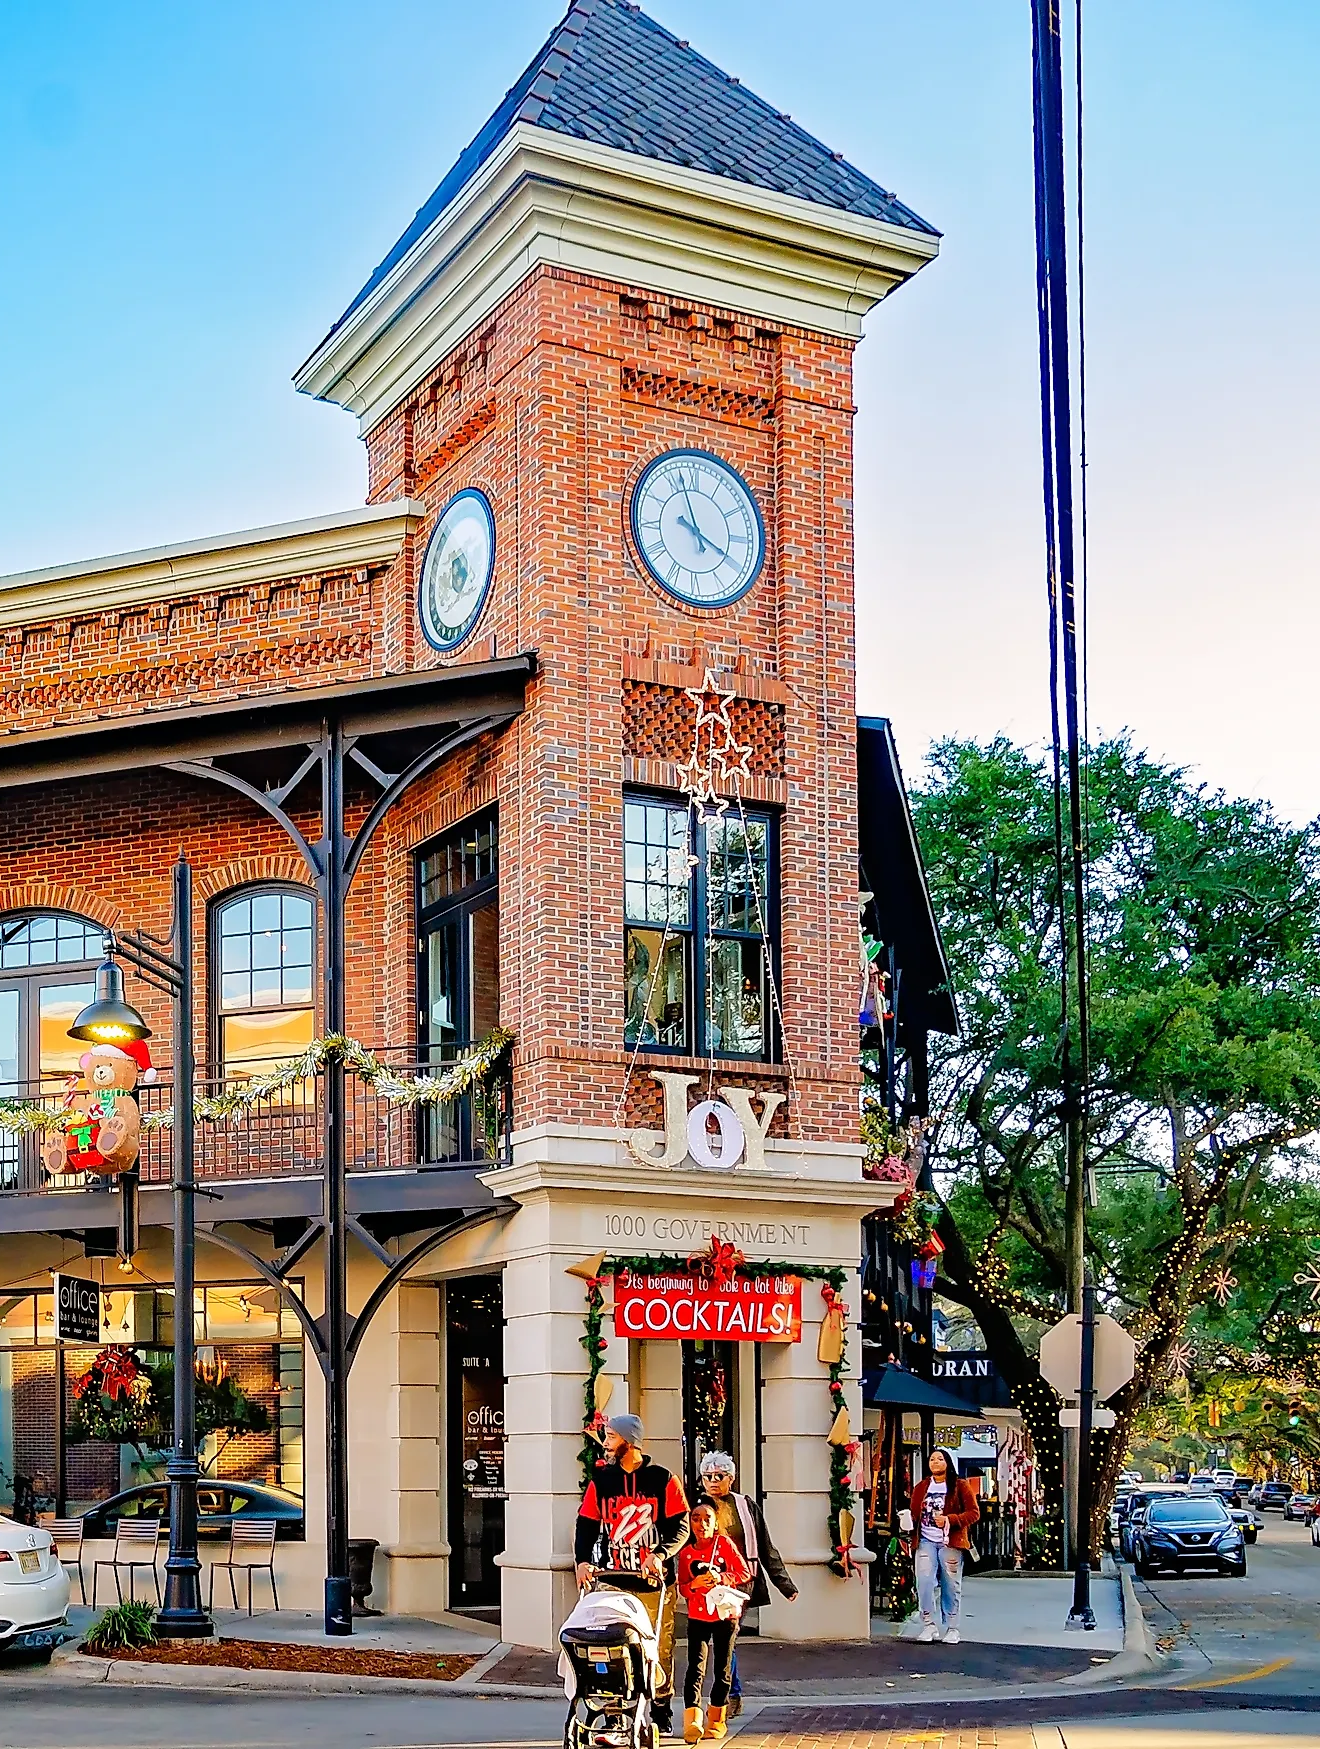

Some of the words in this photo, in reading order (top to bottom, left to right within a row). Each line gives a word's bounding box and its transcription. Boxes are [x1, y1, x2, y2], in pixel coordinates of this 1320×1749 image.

[629, 1070, 787, 1171] JOY
[605, 1214, 646, 1237] 1000
[653, 1217, 811, 1245] GOVERNMENT
[60, 1280, 98, 1313] office
[623, 1275, 644, 1291] It's
[647, 1275, 694, 1295] beginning
[698, 1276, 709, 1292] to
[719, 1276, 739, 1293] ook
[743, 1281, 751, 1293] a
[755, 1276, 770, 1294] lot
[774, 1277, 795, 1295] like
[60, 1311, 70, 1321] bar
[79, 1314, 98, 1328] lounge
[623, 1298, 794, 1335] COCKTAILS!
[462, 1357, 480, 1367] SUITE
[467, 1406, 504, 1425] offic
[614, 1503, 653, 1545] 23
